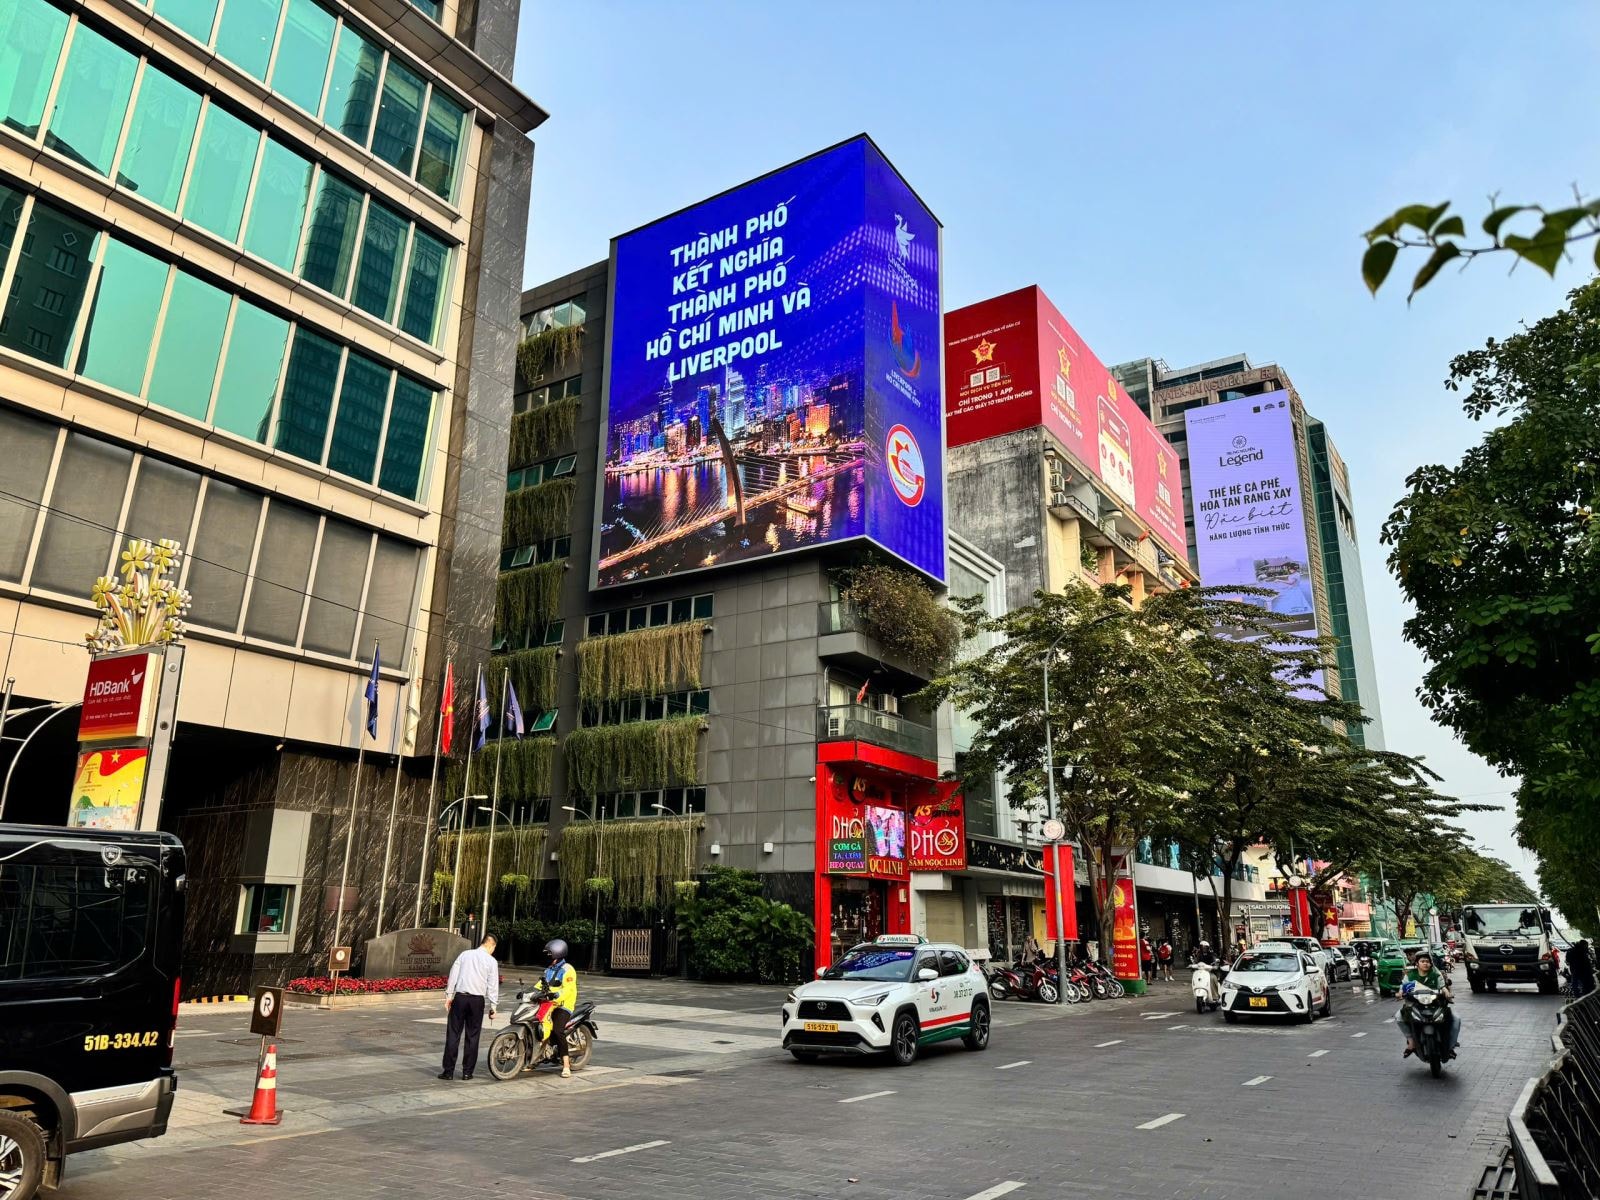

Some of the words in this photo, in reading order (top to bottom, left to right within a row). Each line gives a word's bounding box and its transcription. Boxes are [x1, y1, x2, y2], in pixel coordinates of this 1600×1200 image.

[670, 224, 738, 267] THÀNH
[746, 195, 796, 239] PHỐ
[673, 259, 713, 295] KẾT
[720, 236, 783, 278] NGHĨA
[668, 282, 737, 324] THÀNH
[745, 255, 796, 299] PHỐ
[646, 328, 677, 361] HỒ
[679, 313, 715, 350] CHÍ
[718, 299, 774, 337] MINH
[782, 282, 811, 315] VÀ
[669, 329, 783, 382] LIVERPOOL
[971, 390, 993, 403] TRONG
[999, 386, 1014, 396] APP
[1219, 449, 1263, 467] Legend
[1223, 496, 1240, 507] TAN
[1244, 491, 1271, 504] RANG
[1273, 487, 1292, 499] XAY
[89, 680, 129, 697] HDBank
[914, 805, 932, 816] K5
[911, 820, 958, 856] PHỞ
[829, 861, 844, 869] HEO
[845, 861, 864, 870] QUAY
[883, 859, 903, 875] LINH
[924, 859, 944, 868] NGỌC
[84, 1031, 159, 1051] 51B-334.42
